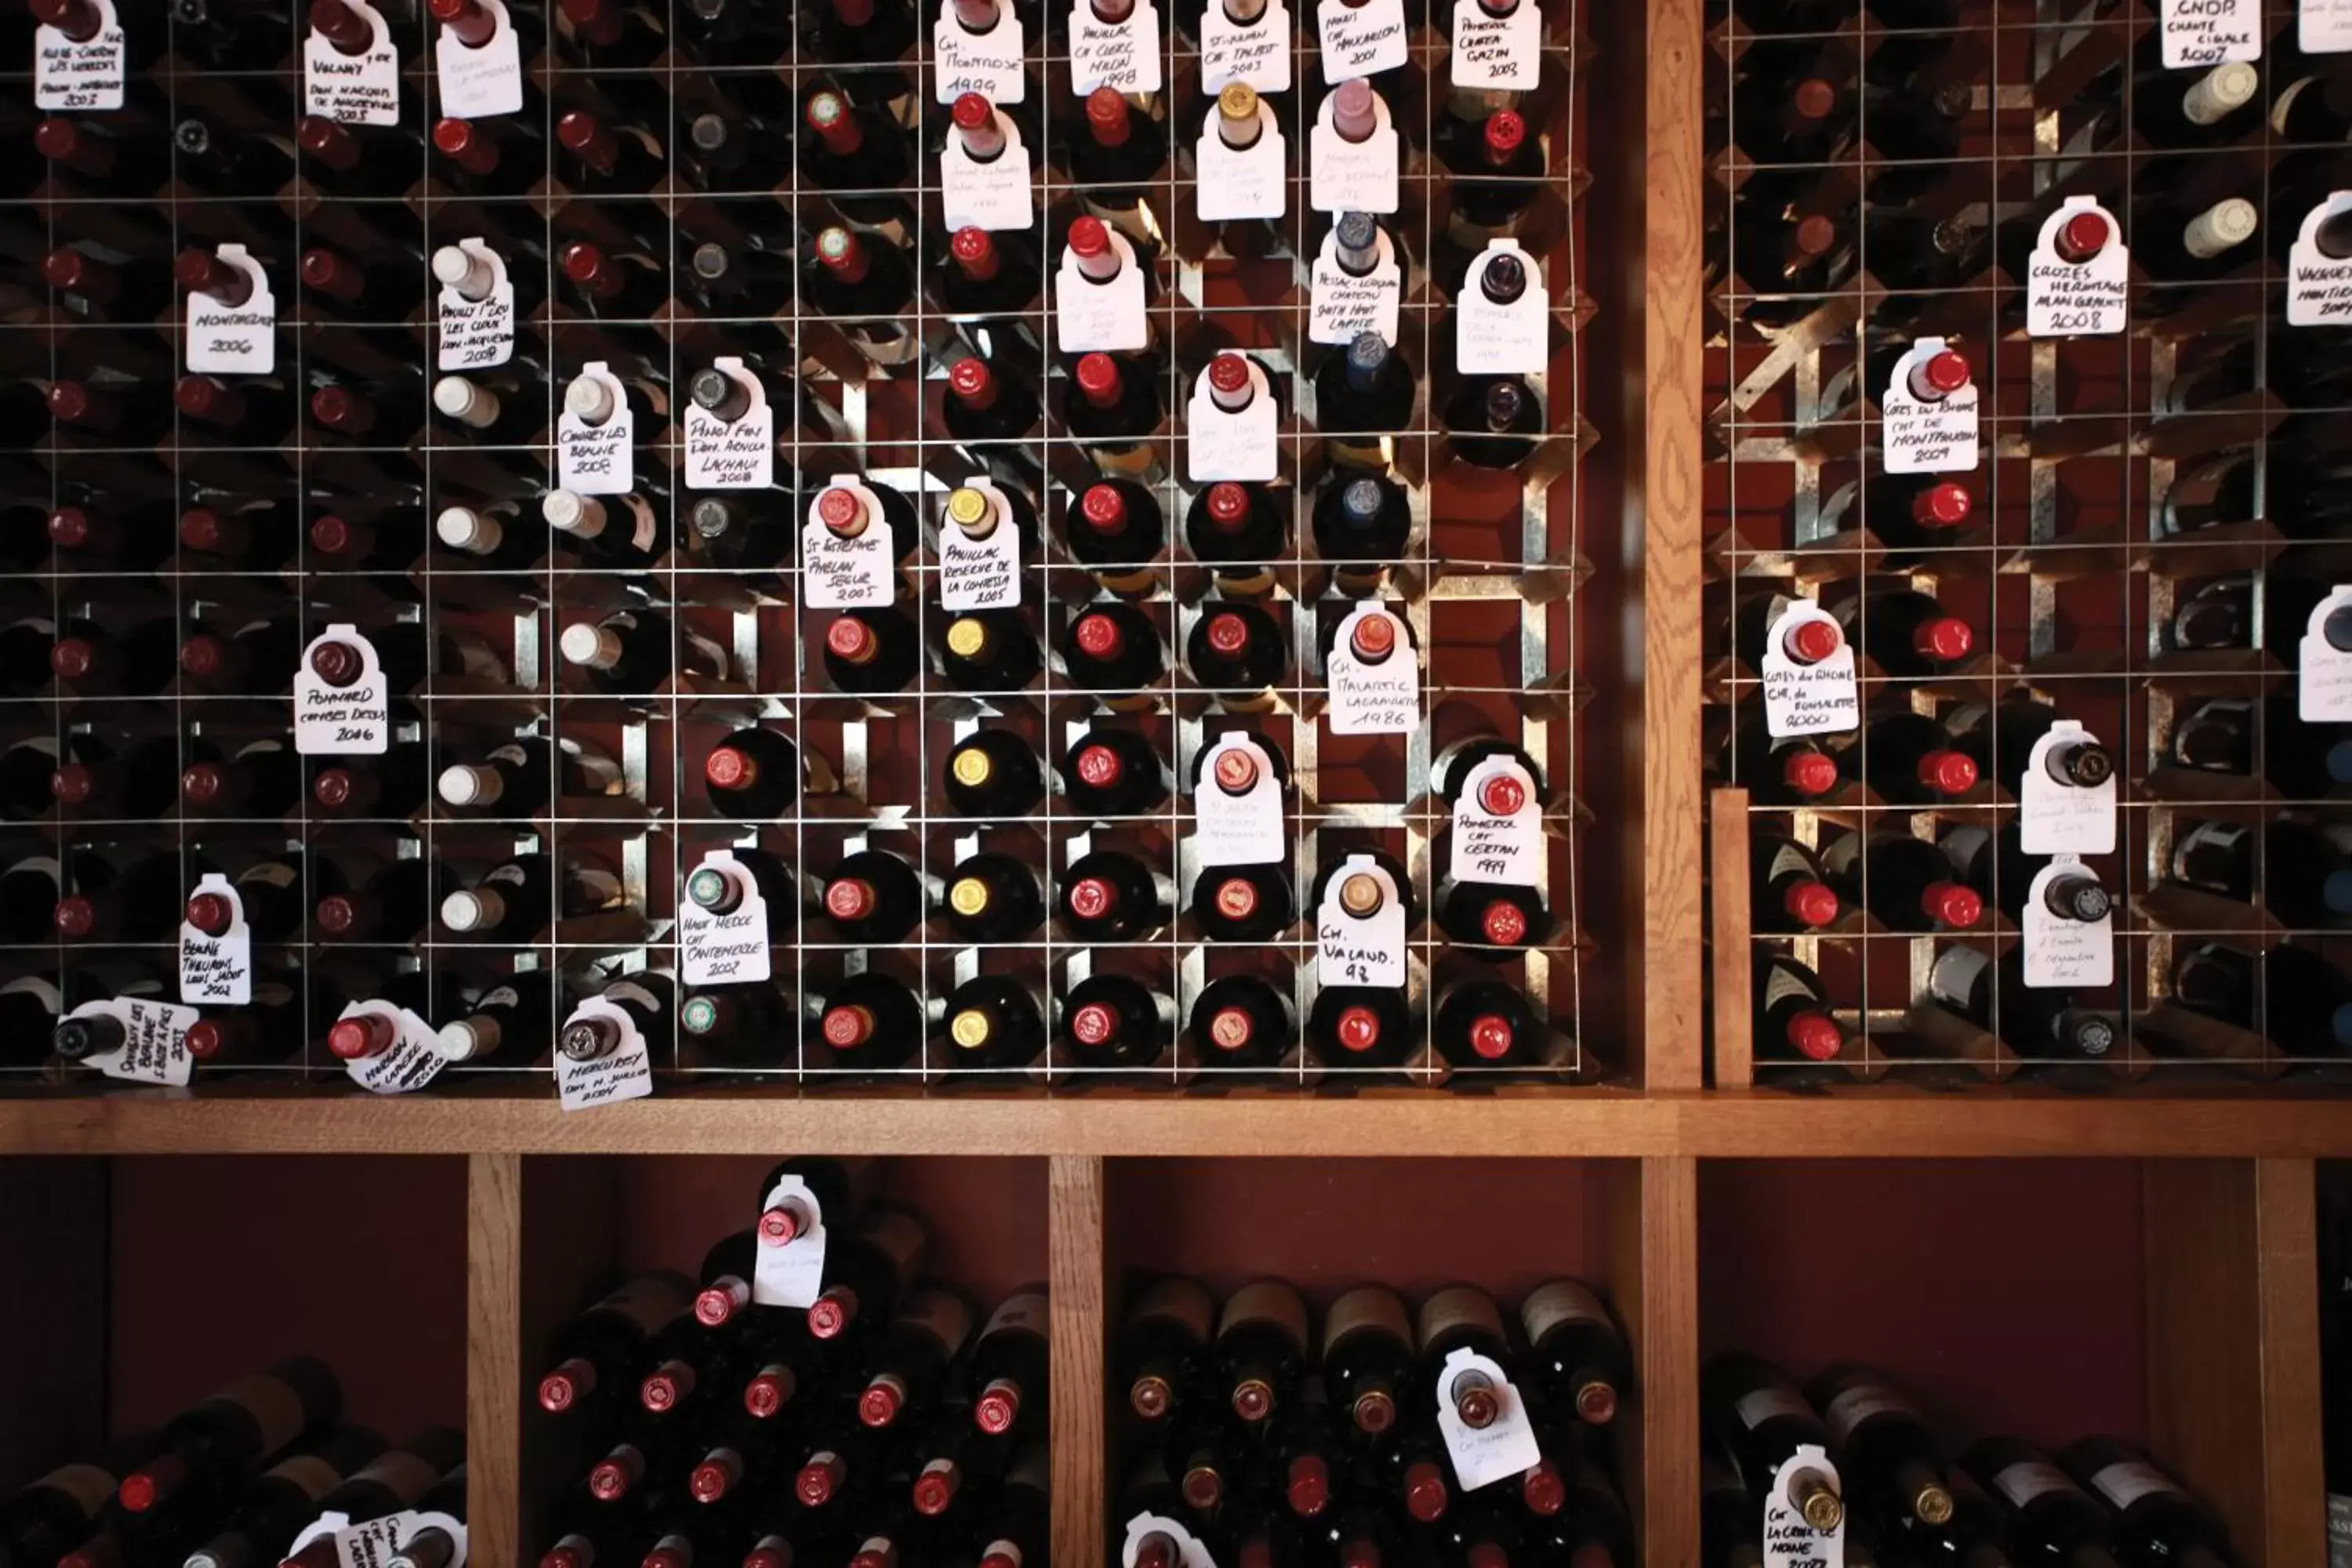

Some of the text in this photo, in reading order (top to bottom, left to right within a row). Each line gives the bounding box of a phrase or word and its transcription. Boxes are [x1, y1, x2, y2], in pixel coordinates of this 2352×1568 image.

[2169, 22, 2215, 32] CHANTE
[2198, 32, 2249, 43] CIGALE
[2182, 48, 2226, 60] 2007
[2033, 267, 2091, 279] CROZES
[2051, 311, 2100, 329] 2008
[837, 586, 877, 599] 2005
[1352, 713, 1404, 725] 1986
[1786, 716, 1829, 727] 2000
